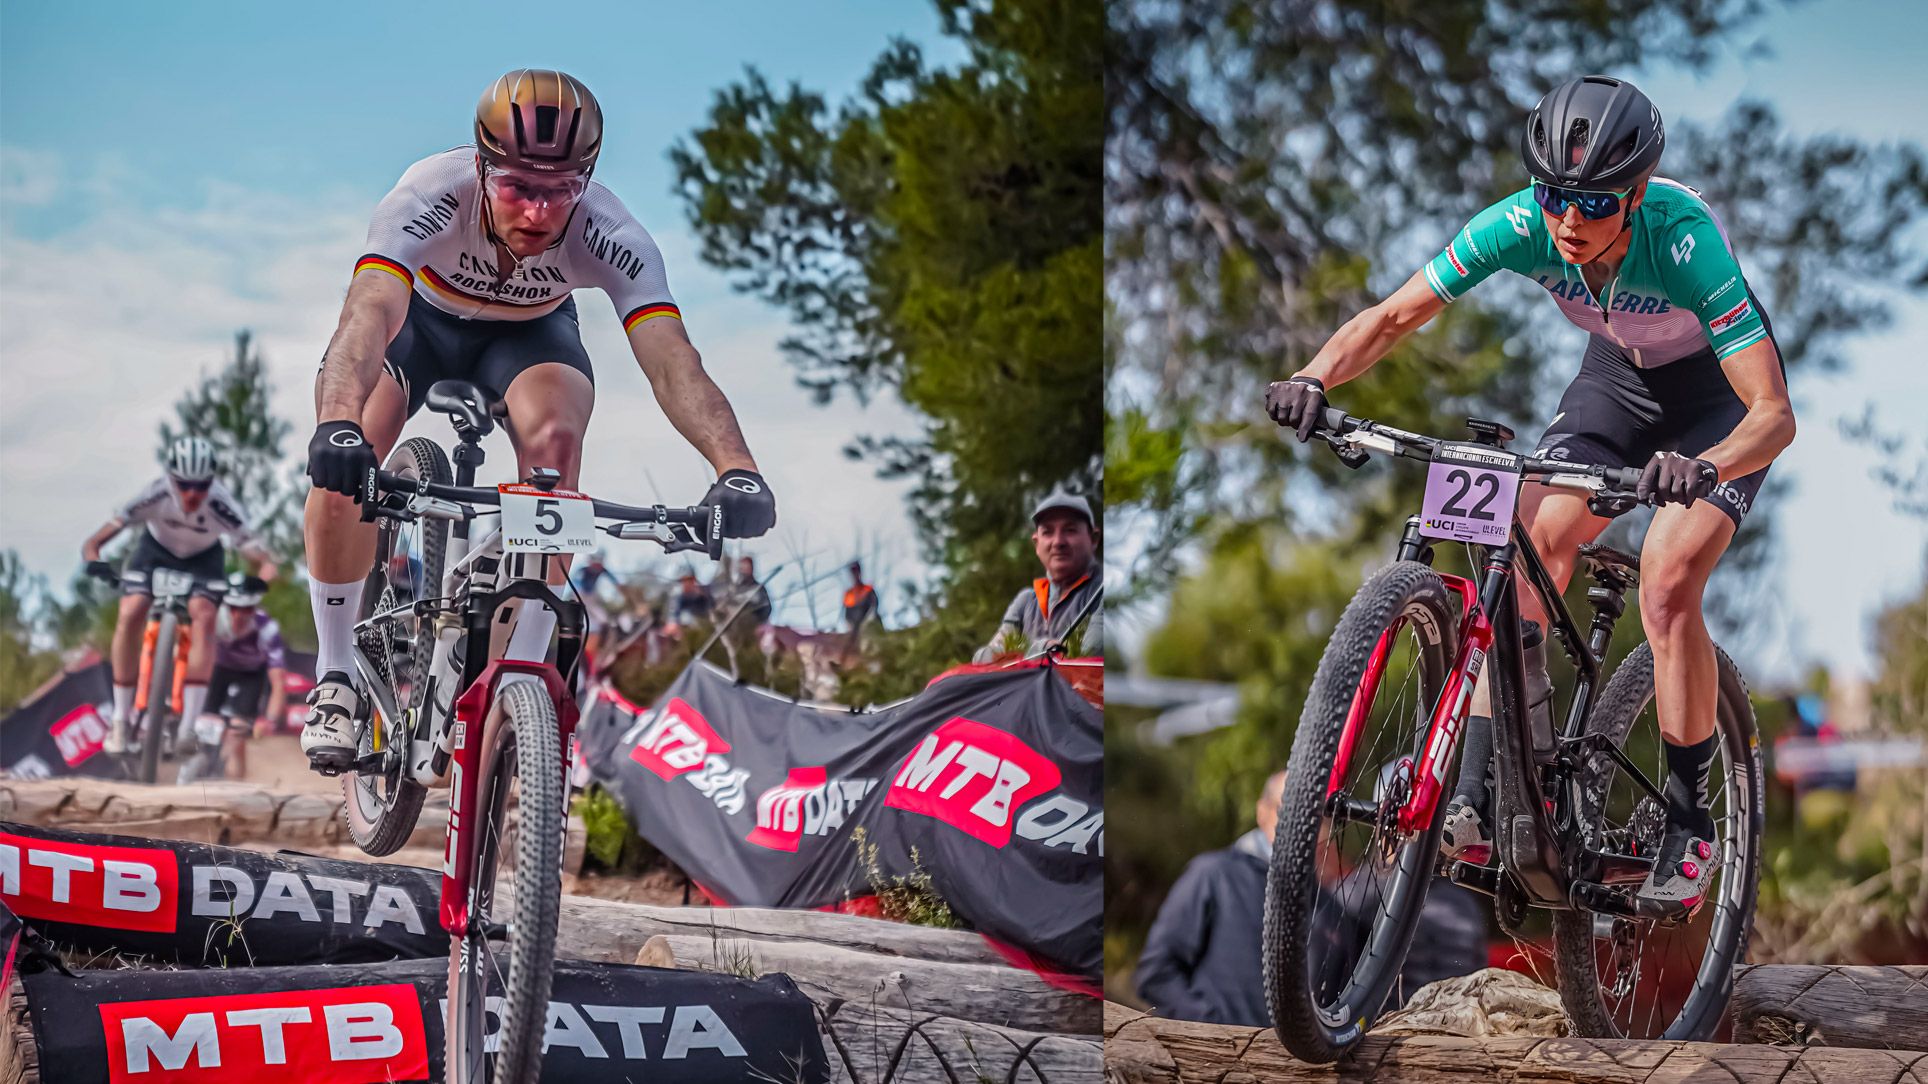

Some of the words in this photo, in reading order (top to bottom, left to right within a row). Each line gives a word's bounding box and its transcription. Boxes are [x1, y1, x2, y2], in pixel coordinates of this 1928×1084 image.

[402, 193, 460, 240] CANYON
[582, 217, 644, 281] CANYON
[368, 467, 377, 502] ERGON
[1440, 469, 1500, 521] 22
[535, 499, 563, 535] 5
[712, 504, 722, 540] ERGON
[1431, 519, 1455, 531] UCI
[514, 538, 538, 547] UCI
[895, 733, 1031, 827] MTB
[192, 866, 427, 935] DATA
[121, 1001, 405, 1074] MTB
